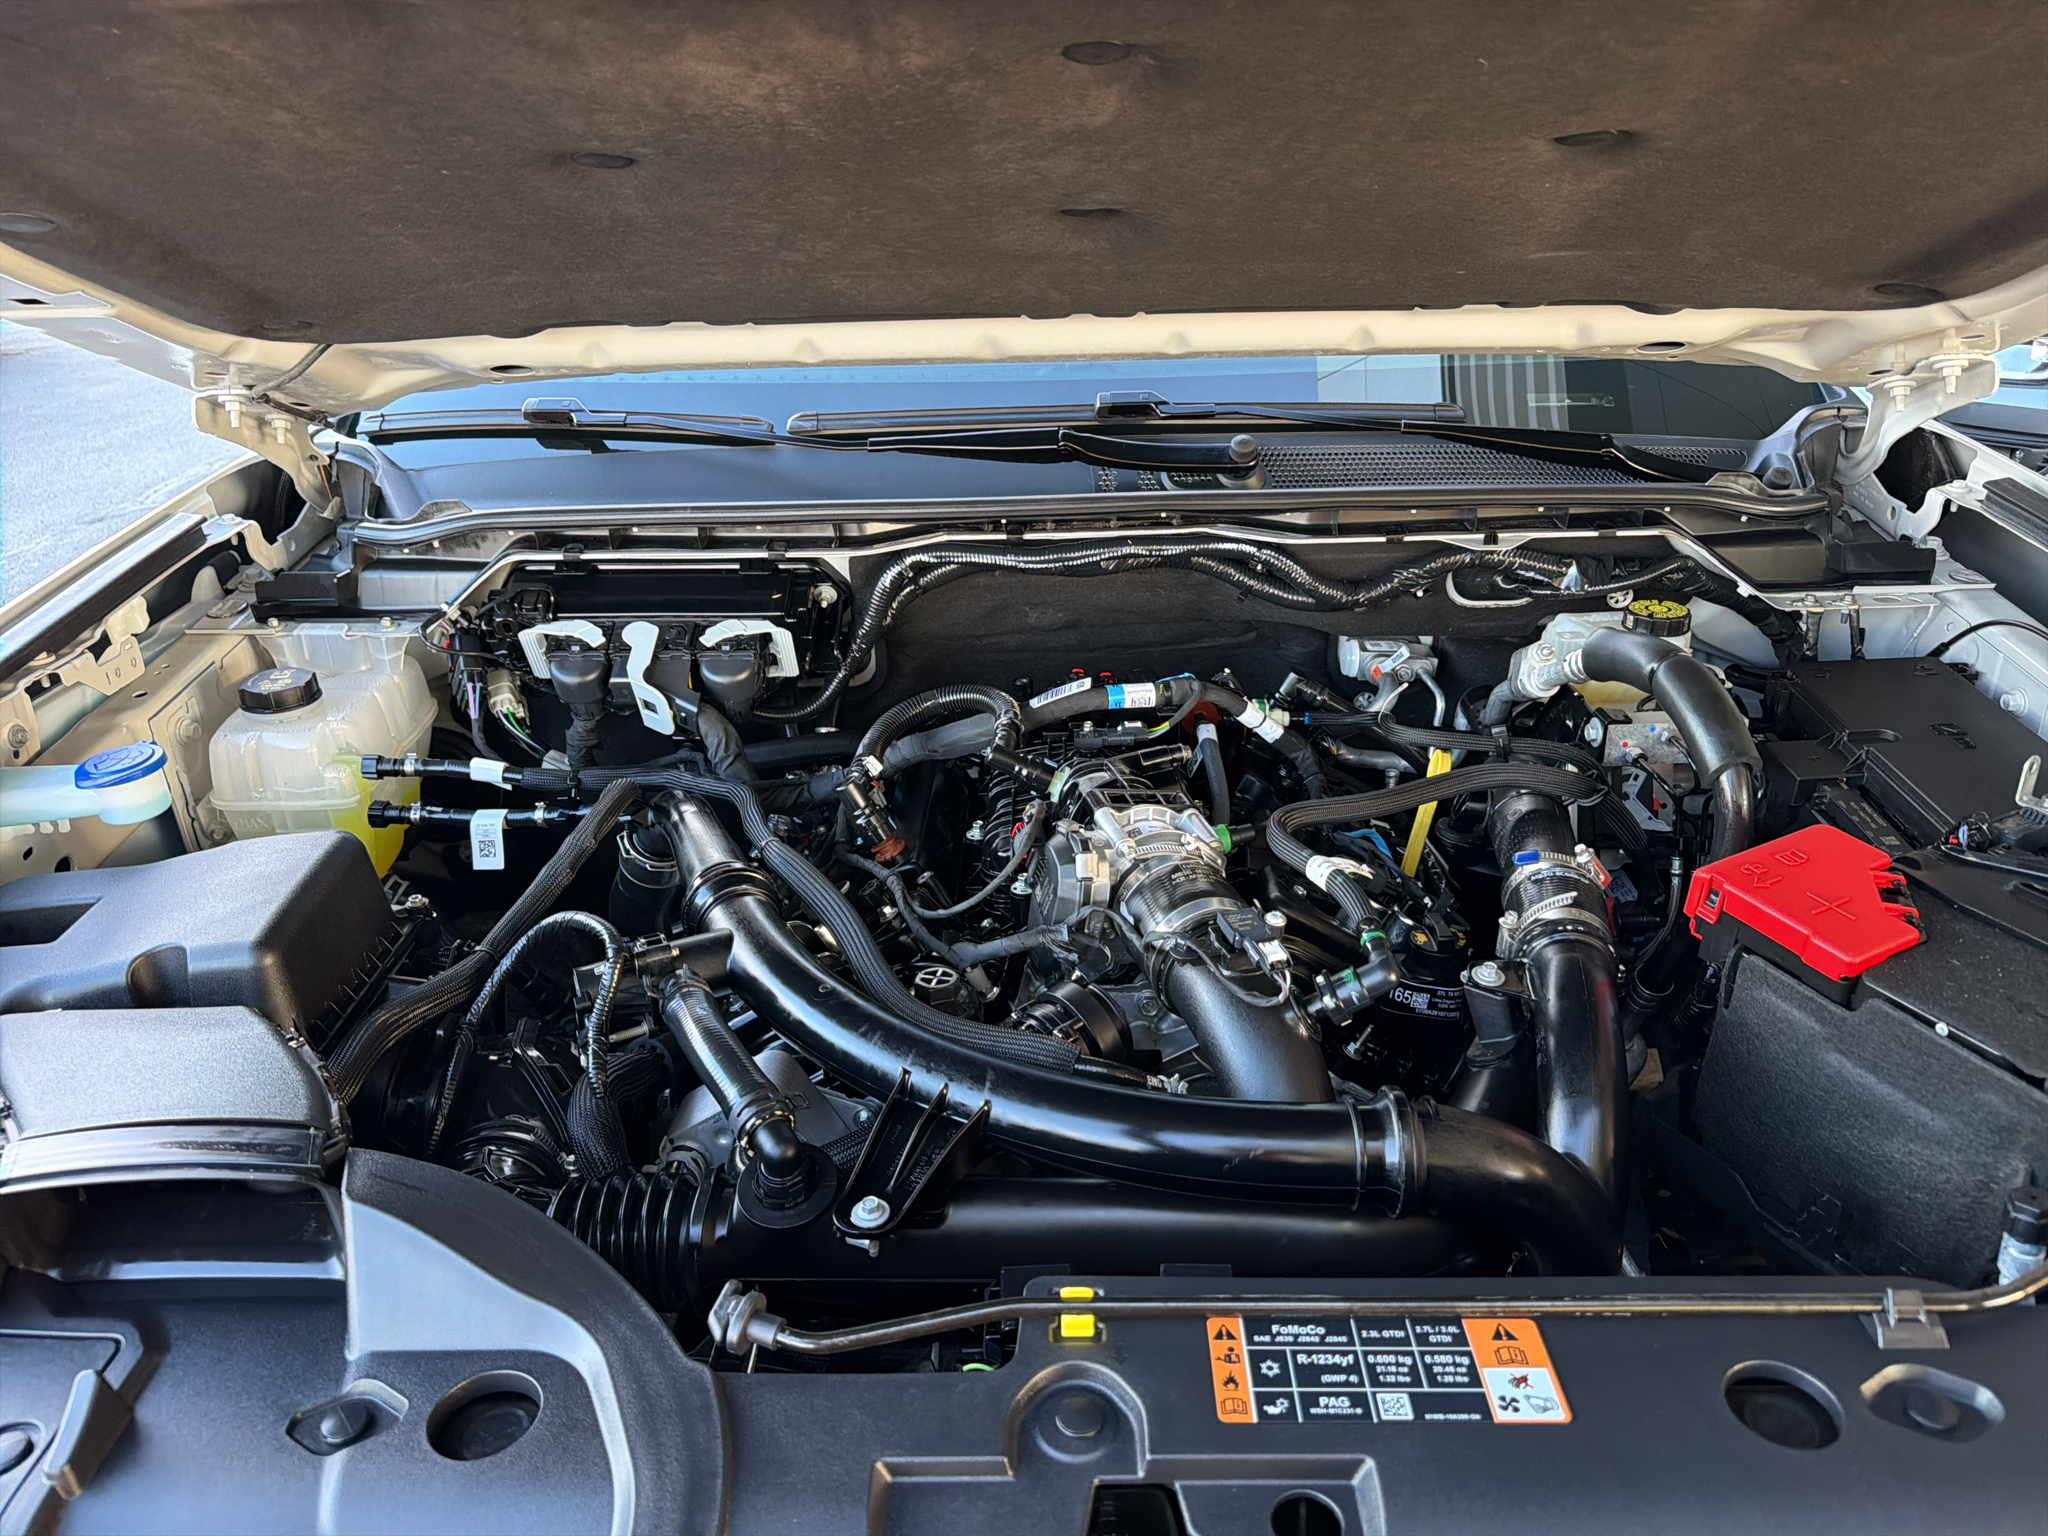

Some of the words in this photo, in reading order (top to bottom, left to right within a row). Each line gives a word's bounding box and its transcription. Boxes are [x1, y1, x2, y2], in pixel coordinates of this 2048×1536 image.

[1271, 1324, 1326, 1335] FoMoCo
[1361, 1329, 1381, 1338] 2.3L
[1381, 1330, 1406, 1339] GTDI
[1414, 1325, 1435, 1334] 2.7L
[1439, 1325, 1461, 1334] 3.0L
[1428, 1334, 1453, 1343] GTDI
[1296, 1353, 1354, 1367] R-1234yf
[1367, 1354, 1396, 1364] 0.600
[1397, 1354, 1413, 1366] kg
[1424, 1354, 1453, 1364] 0.580
[1454, 1354, 1471, 1366] kg
[1376, 1365, 1397, 1373] 21.16
[1432, 1365, 1455, 1373] 20.46
[1320, 1374, 1348, 1384] (GWP
[1348, 1374, 1359, 1384] 4)
[1378, 1375, 1397, 1383] 1.32
[1397, 1375, 1412, 1383] lbs
[1436, 1375, 1454, 1383] 1.28
[1455, 1375, 1471, 1383] lbs
[1318, 1396, 1351, 1408] PAG
